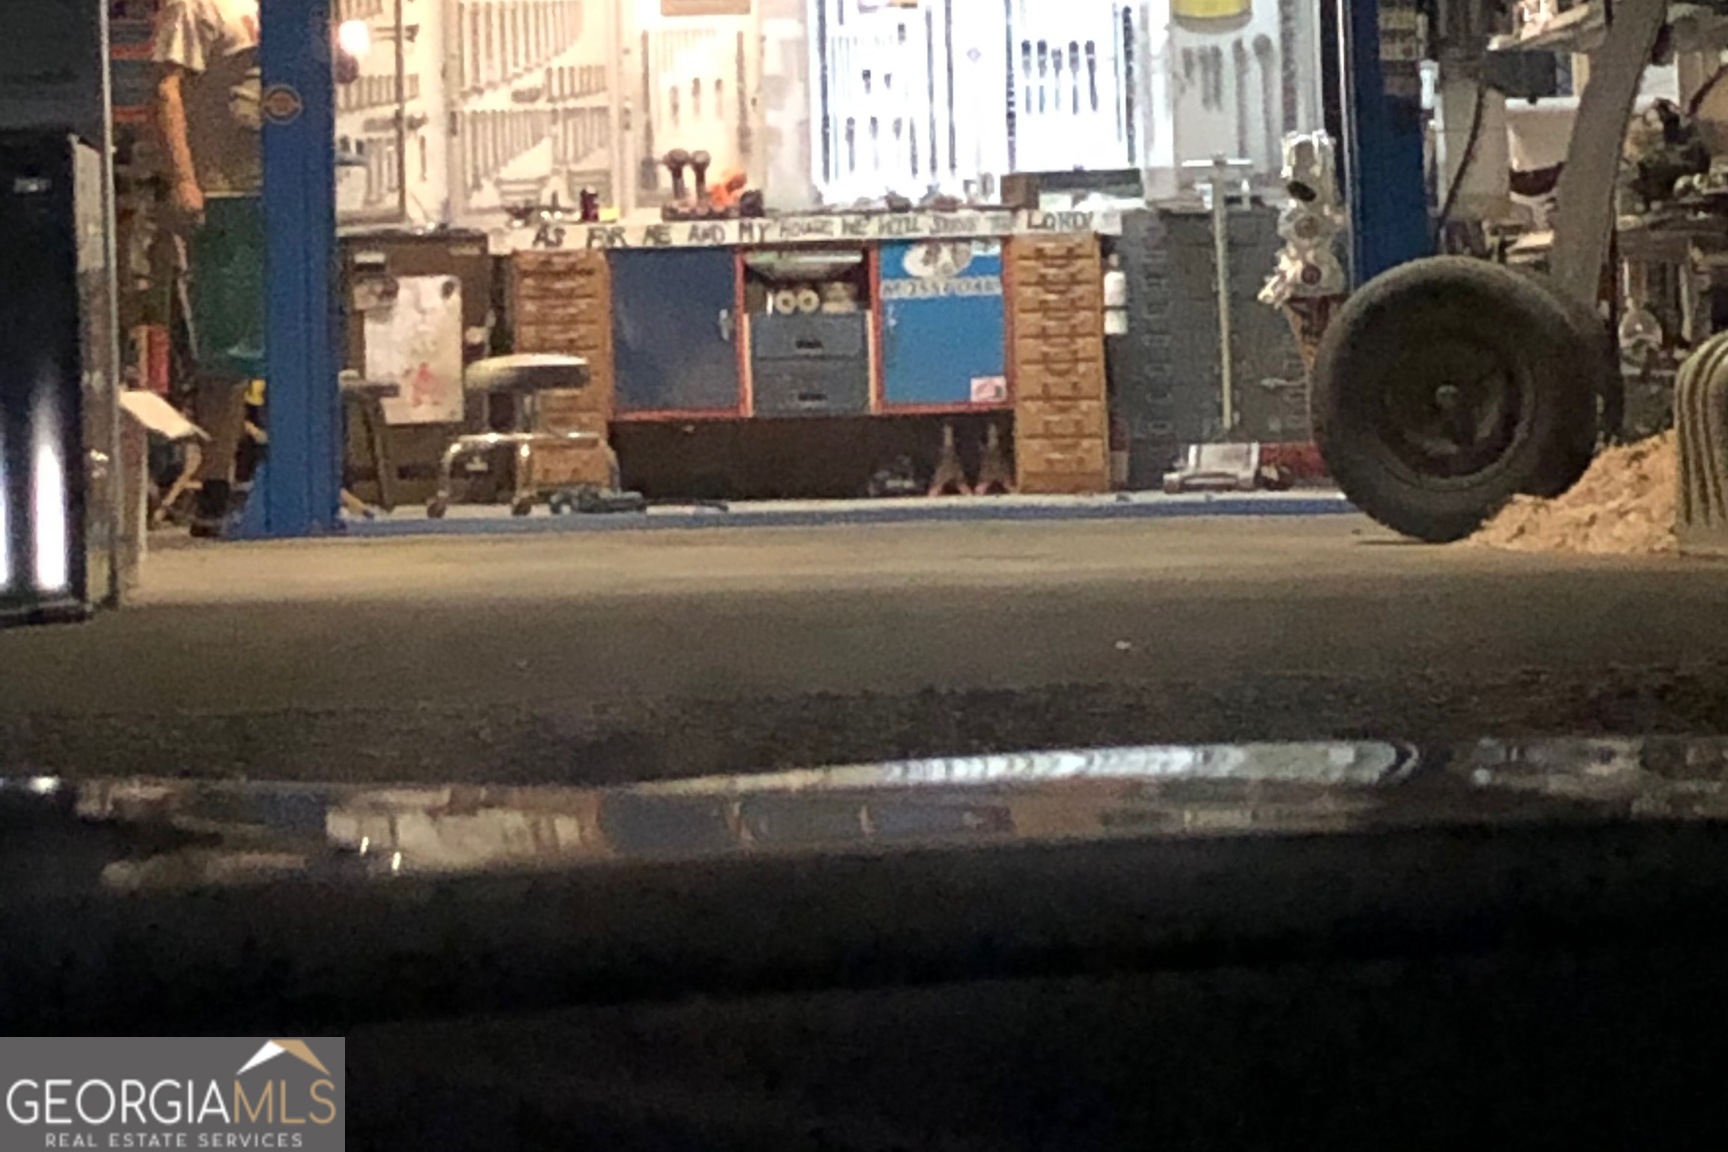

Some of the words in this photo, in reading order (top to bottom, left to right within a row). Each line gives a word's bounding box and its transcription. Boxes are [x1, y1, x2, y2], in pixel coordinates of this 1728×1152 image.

[532, 224, 567, 248] AS
[587, 226, 628, 248] FOR
[643, 224, 672, 245] ME
[688, 224, 726, 244] AND
[739, 219, 773, 244] MY
[780, 218, 834, 238] HOUSE
[841, 217, 868, 237] WE
[878, 214, 921, 235] WILL
